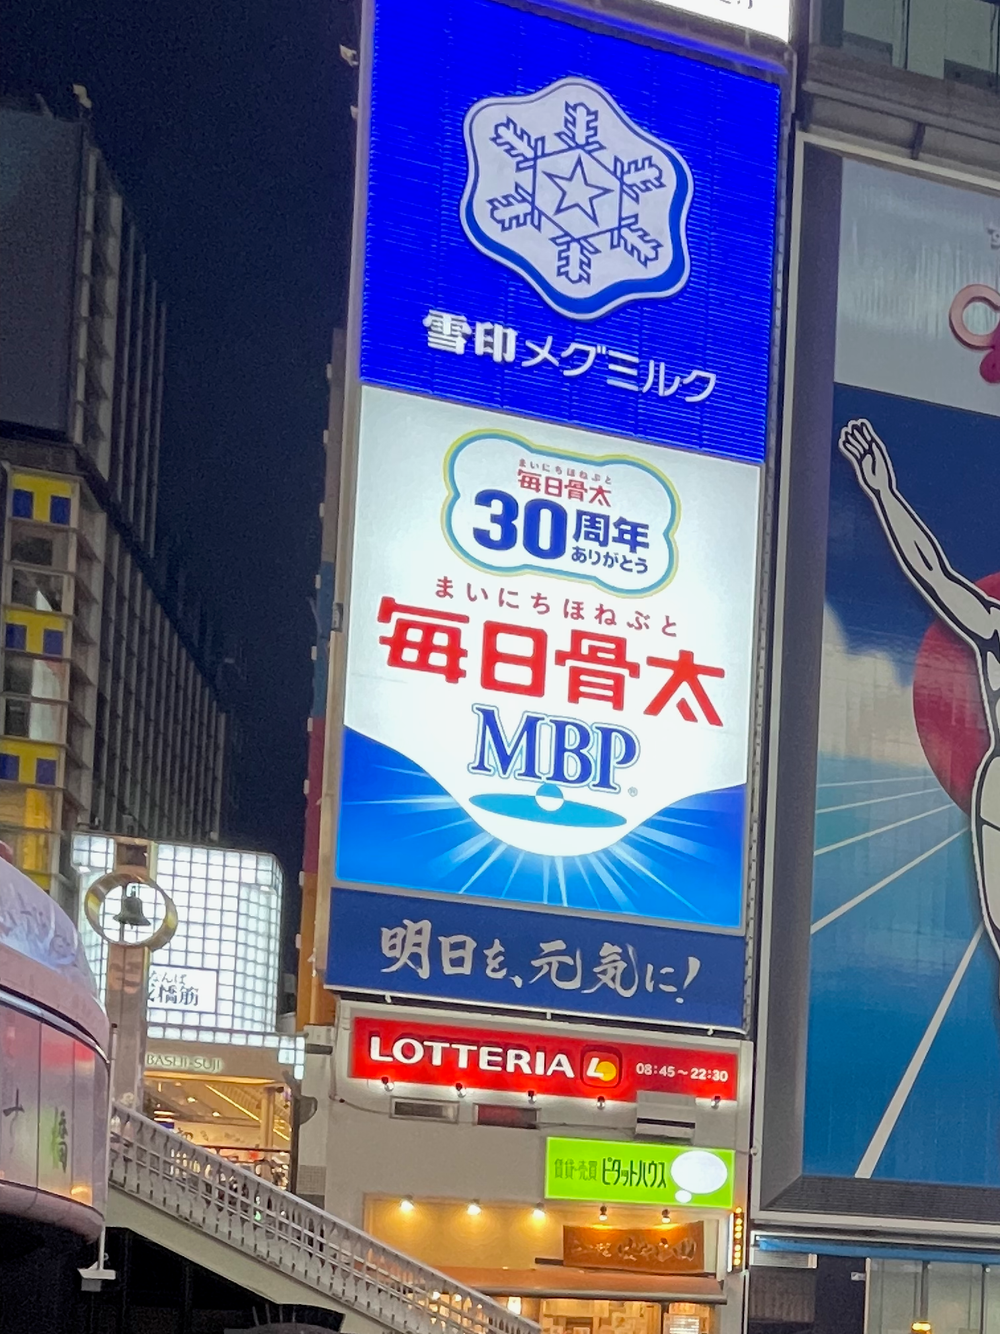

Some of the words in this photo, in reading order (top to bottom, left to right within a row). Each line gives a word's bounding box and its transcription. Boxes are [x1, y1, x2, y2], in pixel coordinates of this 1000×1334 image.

[422, 308, 717, 404] 雪印メグミルク
[517, 469, 612, 507] 毎日骨太
[518, 458, 612, 485] まいにちほねぶと
[571, 546, 648, 575] ありがとう
[435, 575, 678, 638] まいにちほねぶと
[377, 596, 725, 727] 毎日骨太
[469, 703, 640, 794] MBP
[369, 1036, 575, 1079] LOTTERIA
[602, 1156, 667, 1189] ピタットハウス
